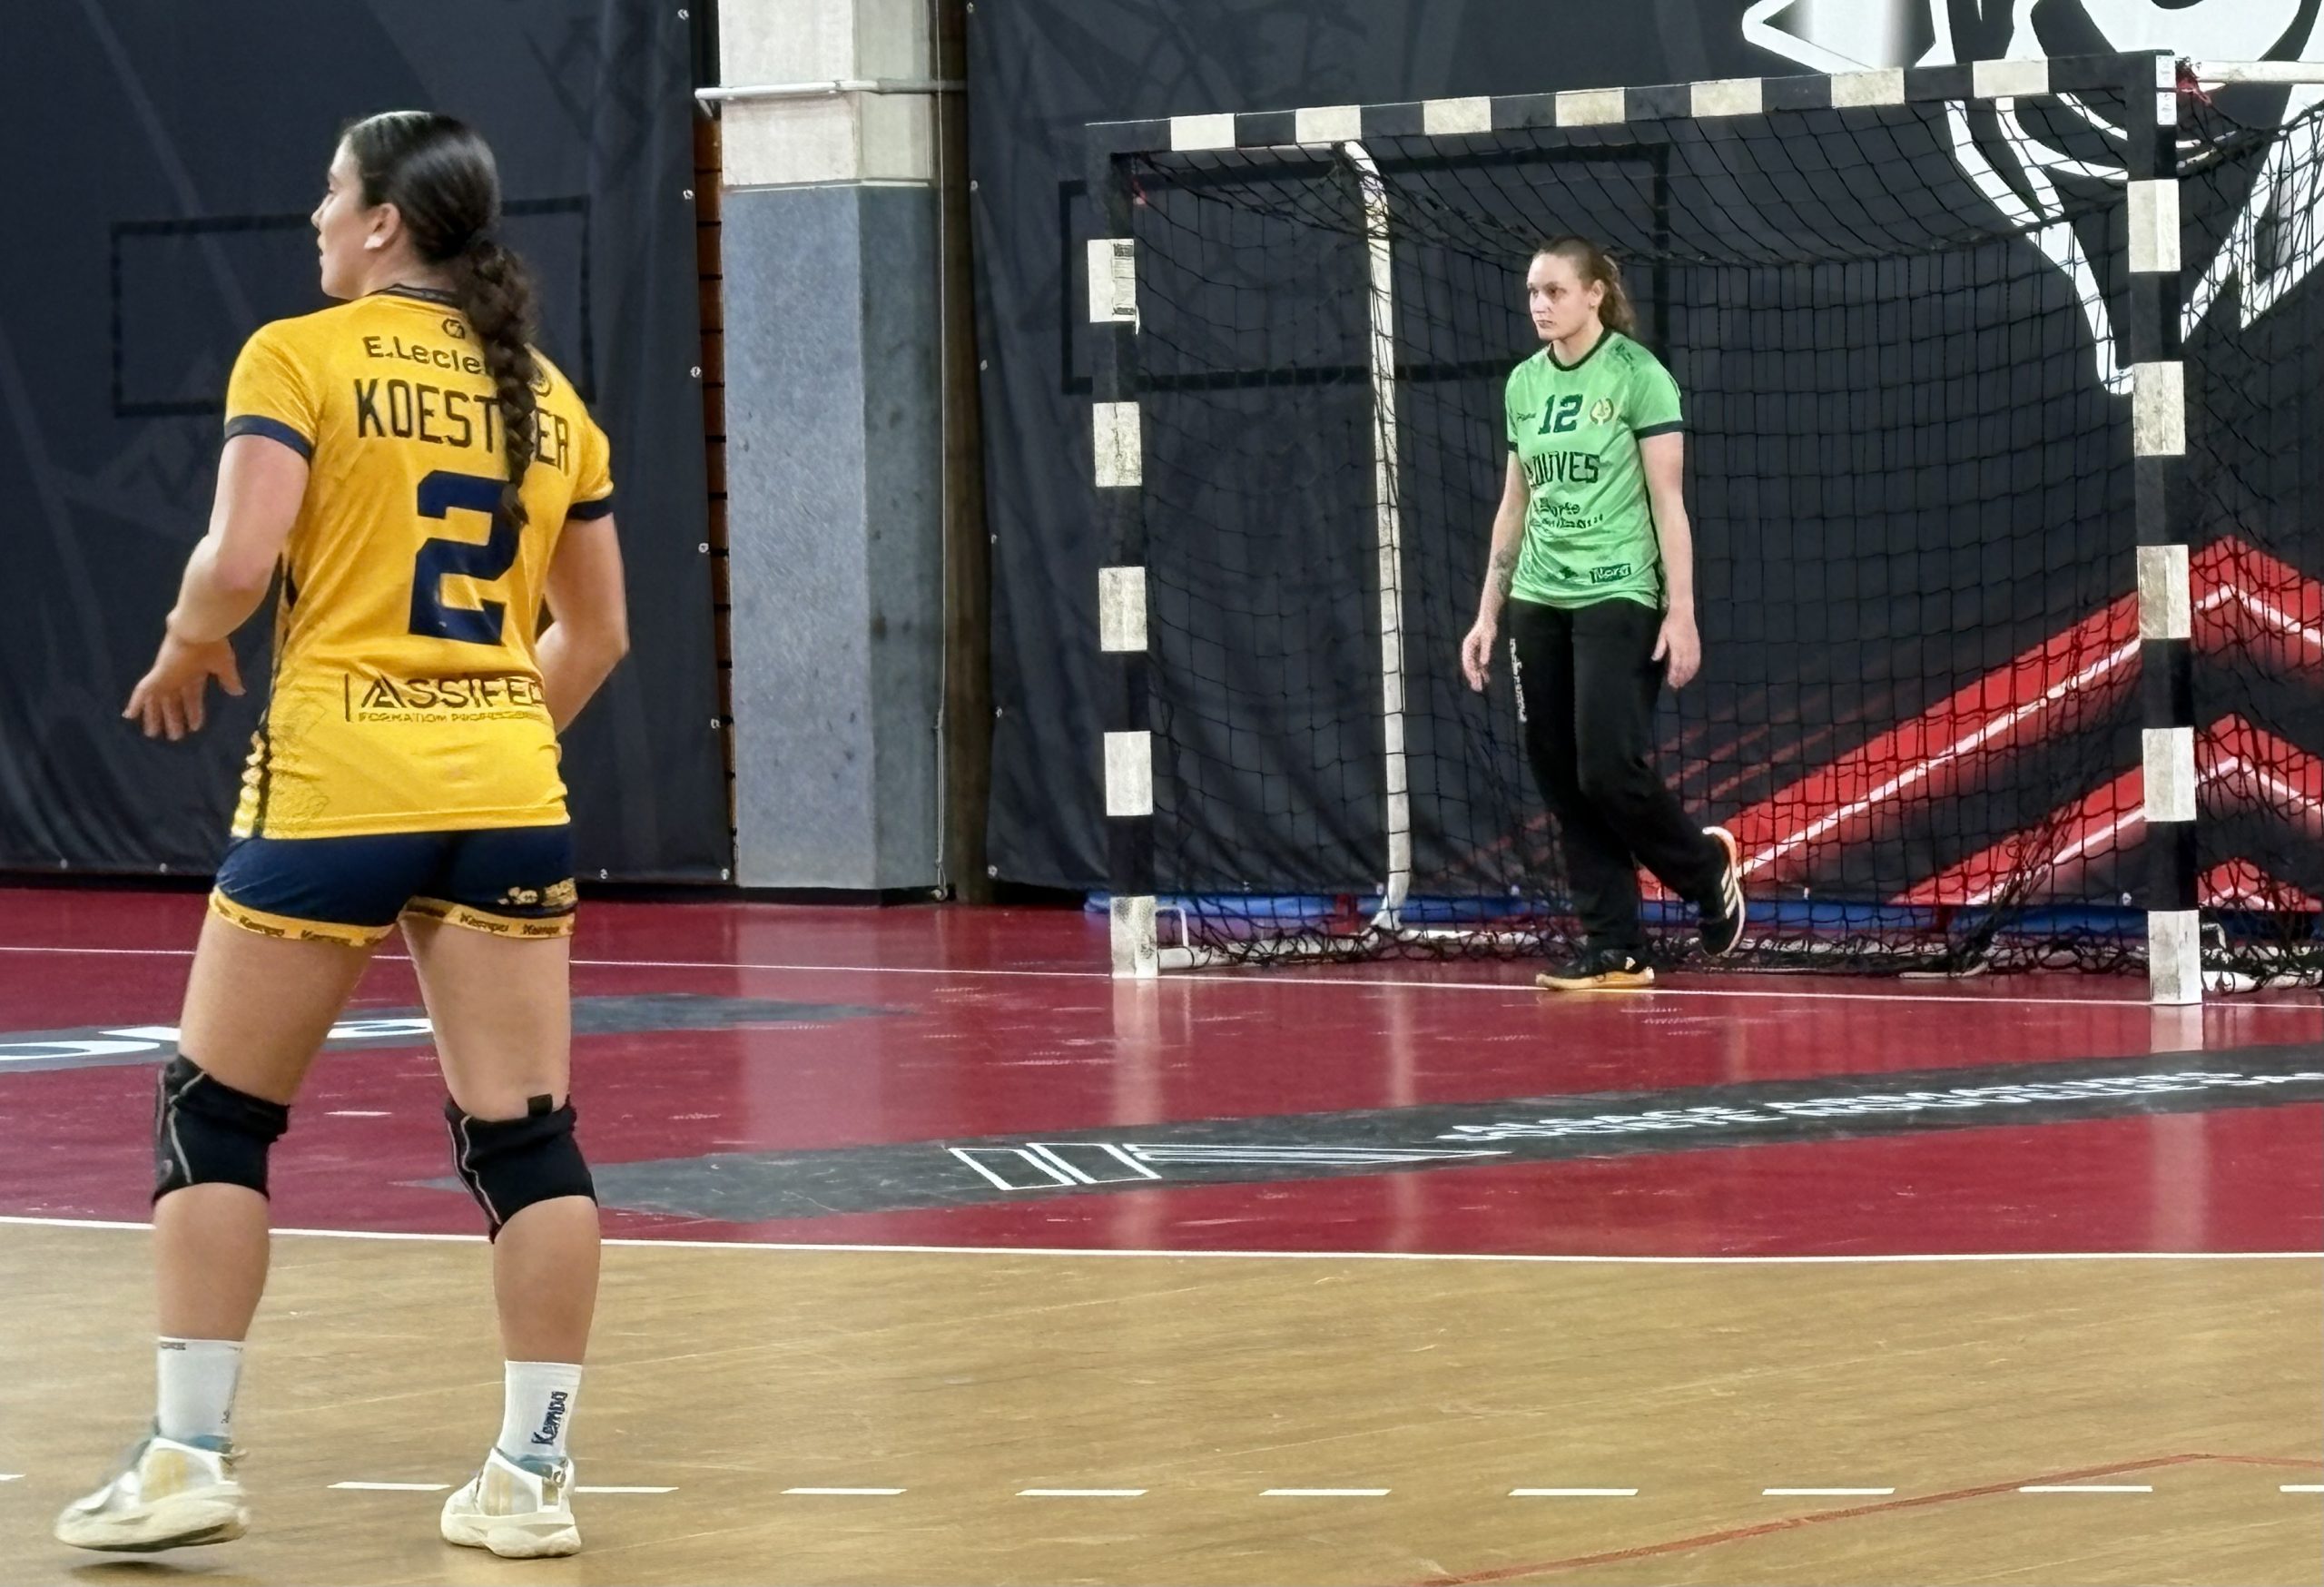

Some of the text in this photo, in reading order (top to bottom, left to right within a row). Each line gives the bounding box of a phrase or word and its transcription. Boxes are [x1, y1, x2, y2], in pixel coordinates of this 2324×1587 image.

[361, 335, 485, 376] E.Lecle
[353, 378, 570, 477] KOESTER
[1538, 393, 1582, 435] 12
[408, 469, 521, 646] 2
